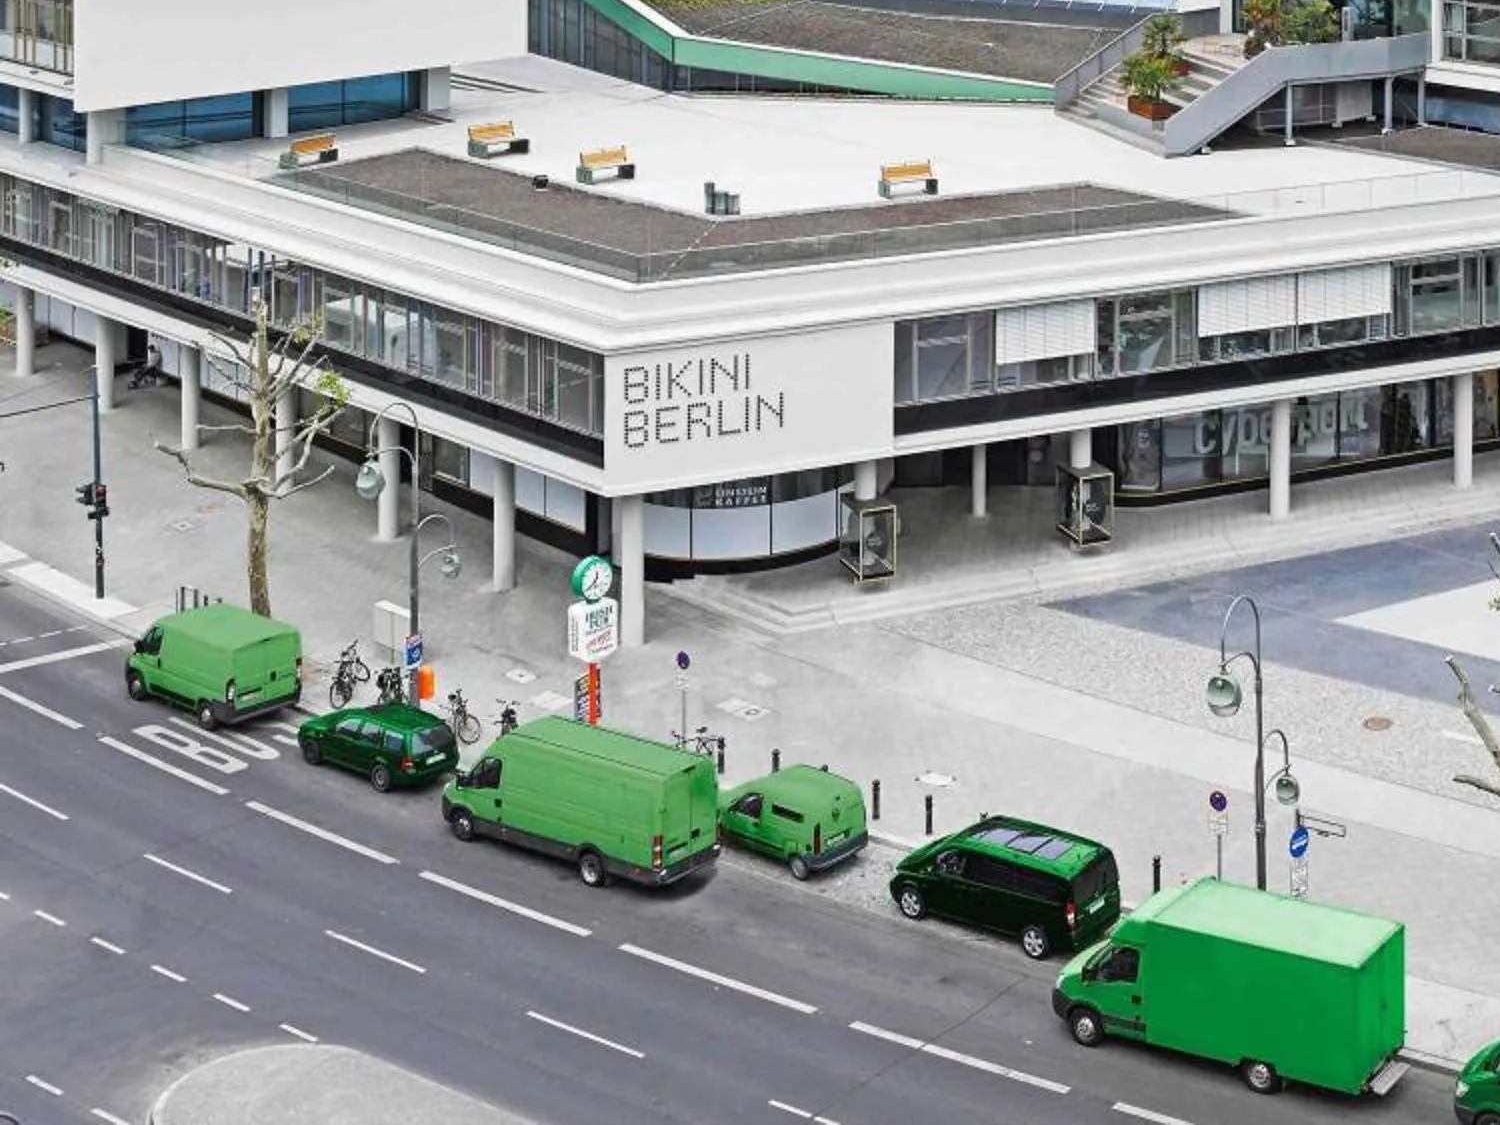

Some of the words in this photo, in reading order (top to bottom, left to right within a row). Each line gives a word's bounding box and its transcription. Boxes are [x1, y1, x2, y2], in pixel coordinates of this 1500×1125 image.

[623, 353, 750, 405] BIKINI
[623, 391, 785, 449] BERLIN
[1194, 398, 1369, 456] Cybeport
